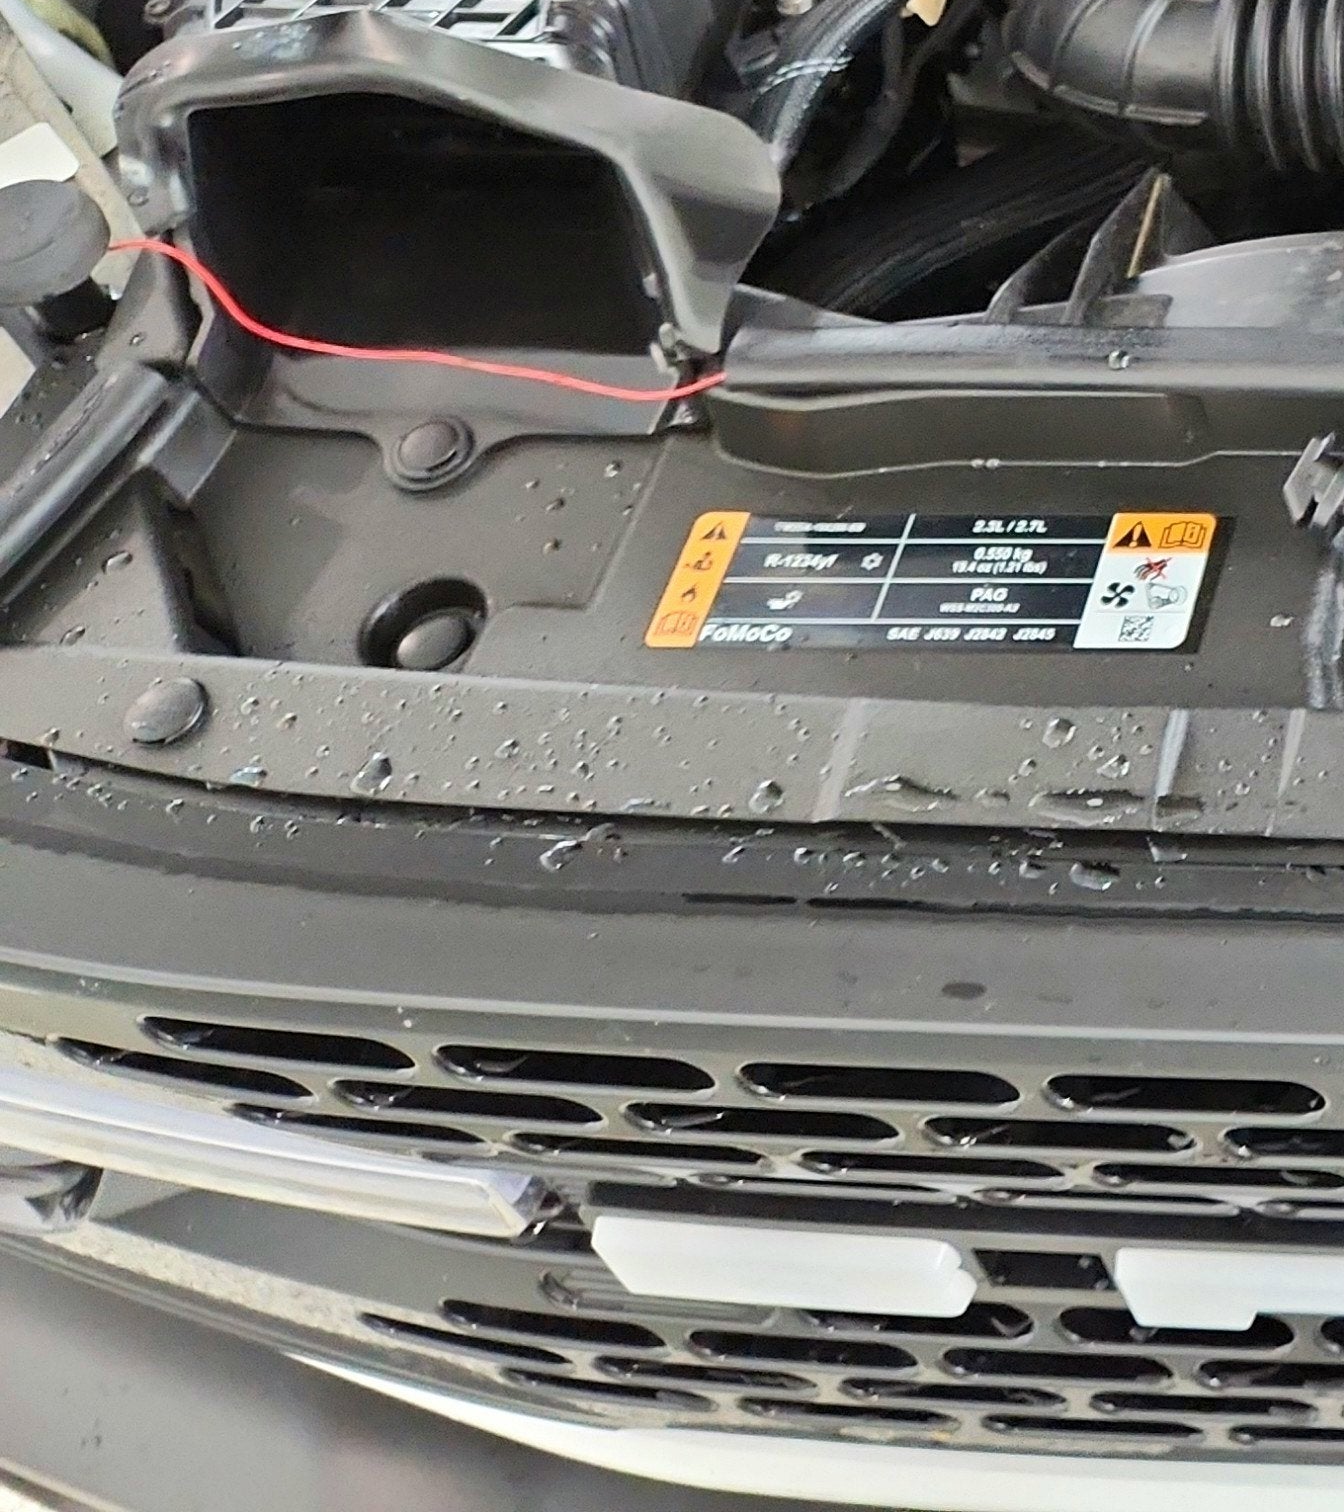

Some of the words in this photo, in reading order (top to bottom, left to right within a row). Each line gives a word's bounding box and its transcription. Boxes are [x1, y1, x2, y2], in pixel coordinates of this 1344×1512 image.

[1014, 519, 1048, 533] 2.7L
[763, 552, 840, 571] R-1234yf
[973, 547, 1013, 561] 0.550
[1012, 547, 1034, 563] kg
[970, 587, 1009, 602] PAG
[698, 624, 794, 643] FoMoCo
[885, 626, 919, 641] SAE
[923, 626, 961, 641] J639
